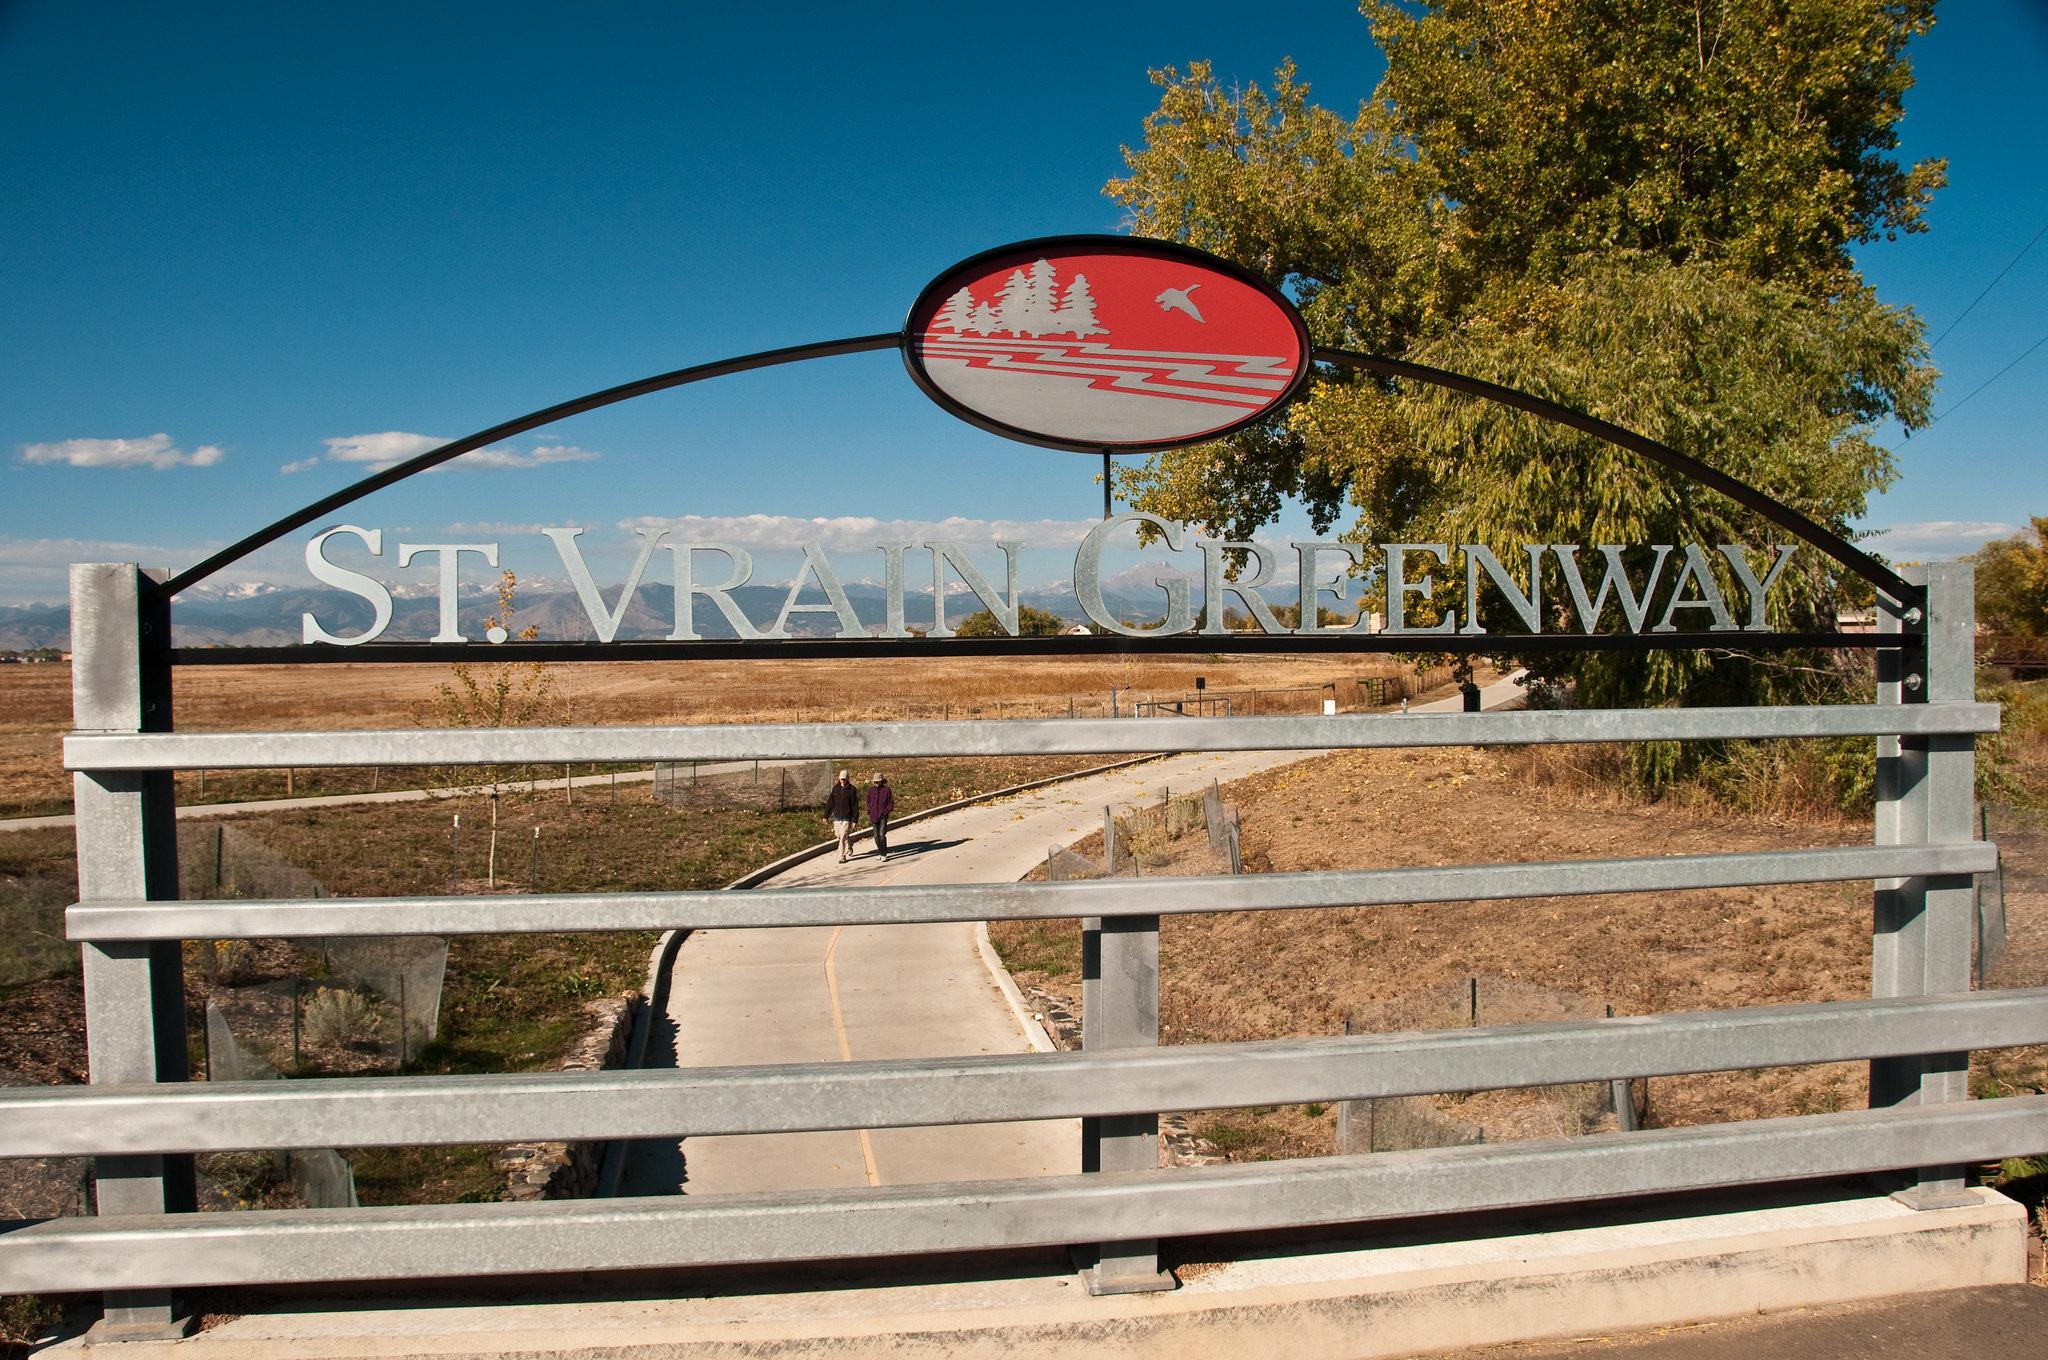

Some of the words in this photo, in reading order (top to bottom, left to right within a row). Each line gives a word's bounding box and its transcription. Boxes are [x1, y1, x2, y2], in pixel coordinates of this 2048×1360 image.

[302, 524, 509, 647] ST.
[542, 527, 1027, 643] VRAIN
[1074, 512, 1798, 638] GREENWAY
